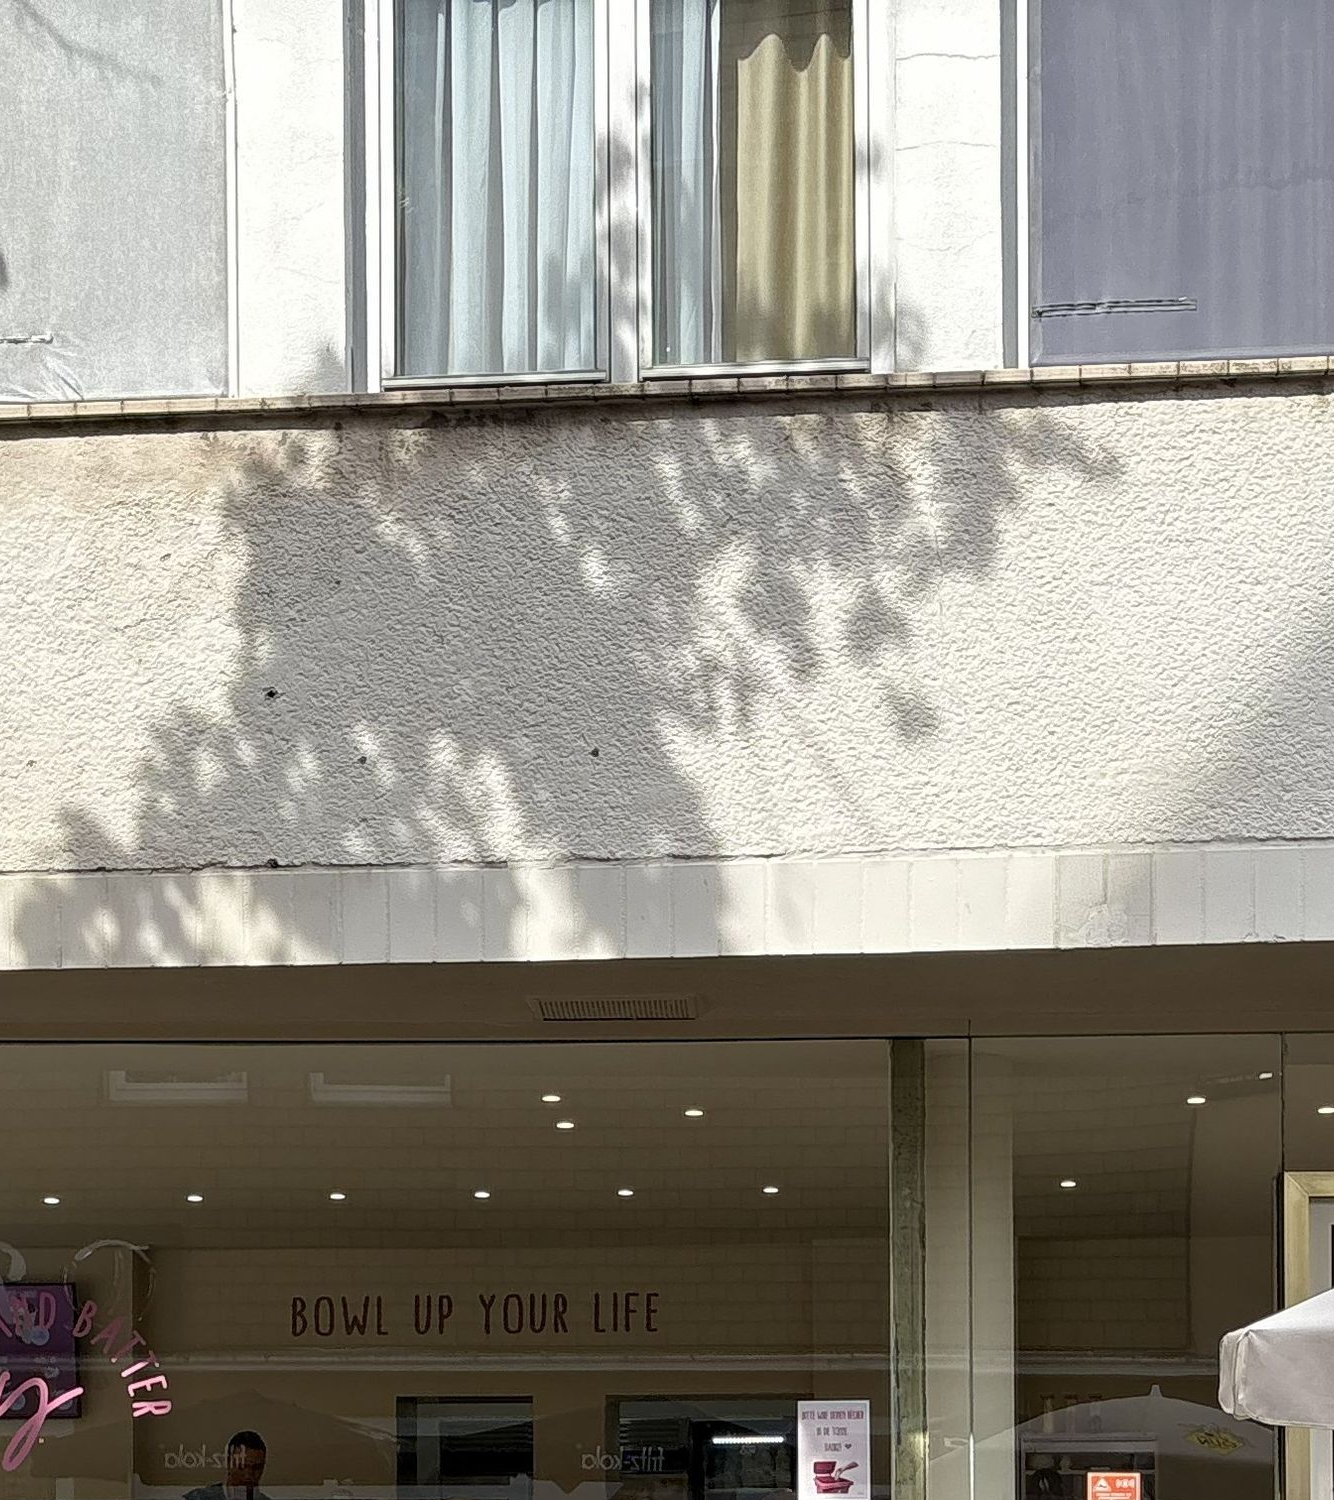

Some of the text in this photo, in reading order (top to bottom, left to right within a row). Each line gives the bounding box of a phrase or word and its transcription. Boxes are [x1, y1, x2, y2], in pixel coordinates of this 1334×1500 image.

[291, 1291, 661, 1336] BOWL UP YOUR LIFE
[71, 1300, 173, 1418] BATTER
